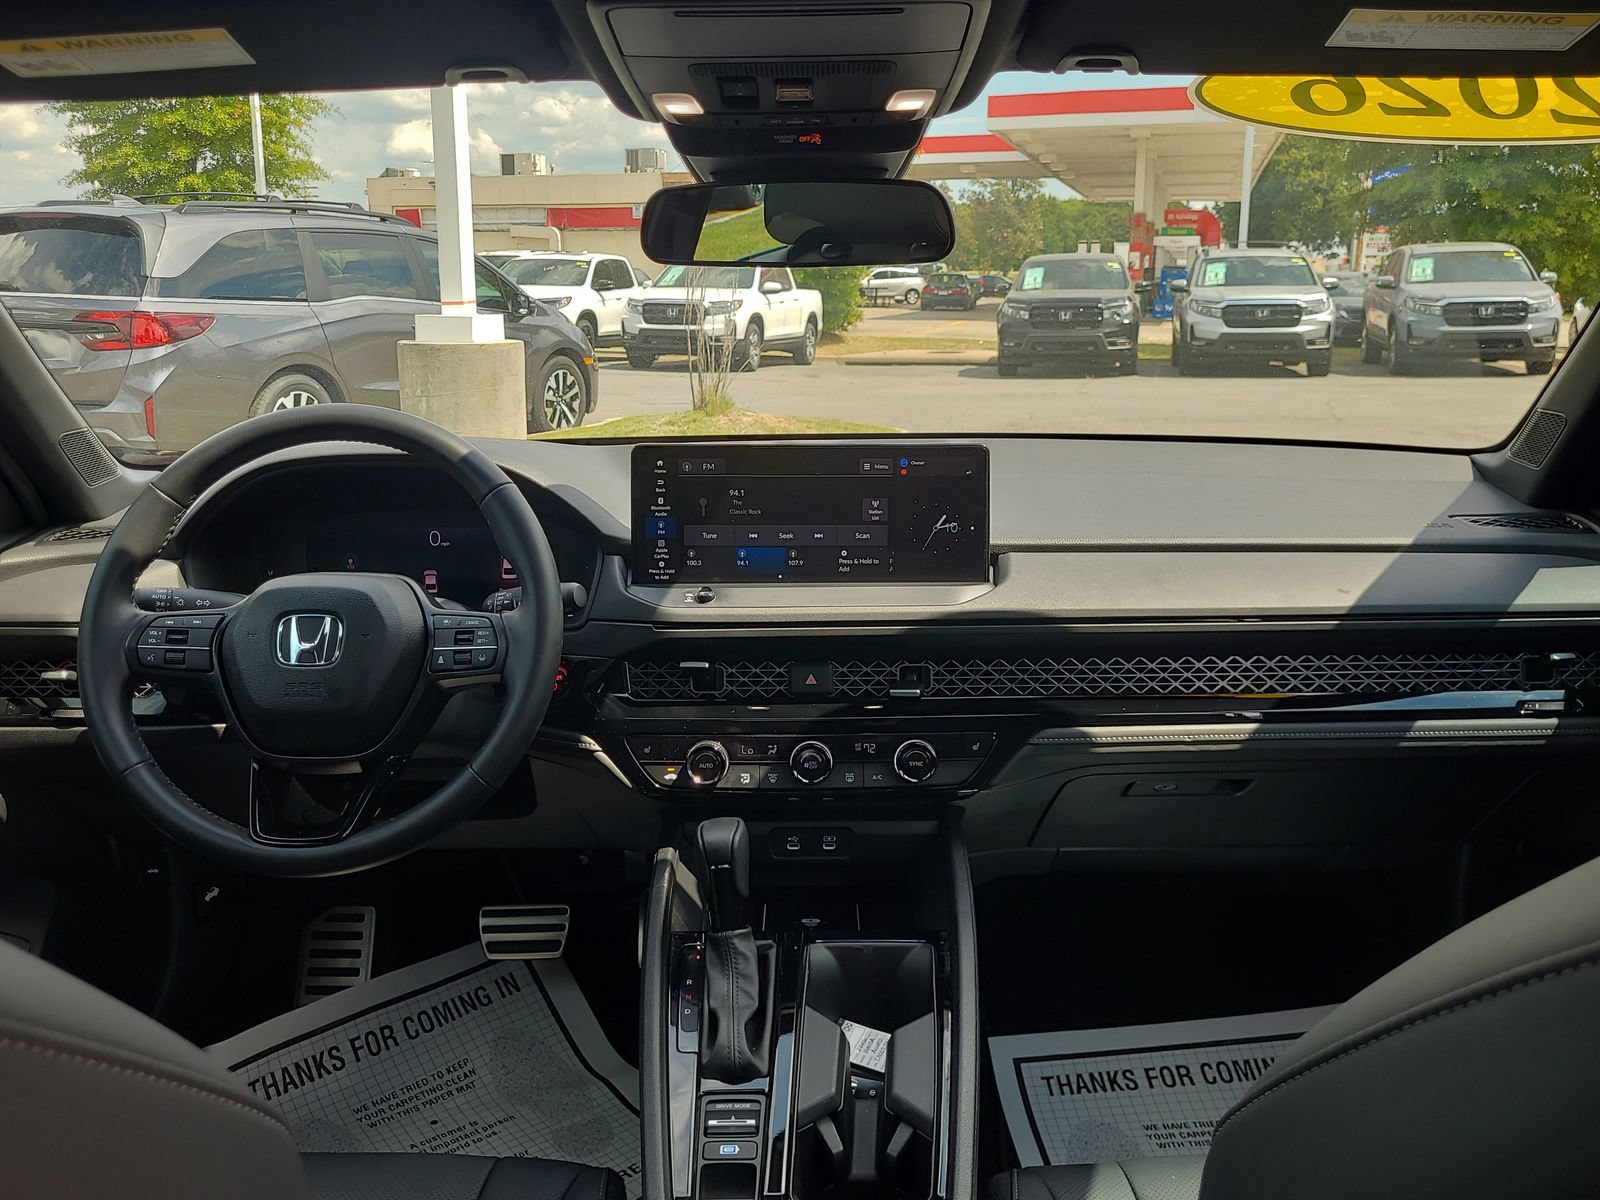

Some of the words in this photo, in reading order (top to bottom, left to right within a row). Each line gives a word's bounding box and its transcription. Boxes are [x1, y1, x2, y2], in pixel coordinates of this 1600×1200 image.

[1426, 14, 1566, 25] WARNING
[56, 33, 194, 49] WARNING
[430, 530, 440, 546] 0
[864, 743, 876, 753] 72
[248, 1045, 346, 1101] THANKS
[350, 1024, 399, 1062] FOR
[402, 986, 493, 1040] COMING
[494, 972, 521, 998] IN
[353, 1104, 370, 1114] WE
[372, 1091, 398, 1107] HAVE
[399, 1078, 429, 1095] TRIED
[431, 1071, 444, 1081] TO
[446, 1058, 469, 1075] KEEP
[1041, 1069, 1139, 1096] THANKS
[1144, 1065, 1196, 1089] FOR
[357, 1108, 386, 1123] YOUR
[388, 1084, 443, 1111] CARPETING
[445, 1068, 477, 1087] CLEAN
[367, 1115, 395, 1128] WITH
[396, 1105, 420, 1118] THIS
[422, 1091, 454, 1108] PAPER
[455, 1081, 477, 1095] MAT
[420, 1124, 466, 1146] customer
[430, 1129, 480, 1152] important
[482, 1115, 516, 1132] person
[486, 1130, 502, 1139] us.
